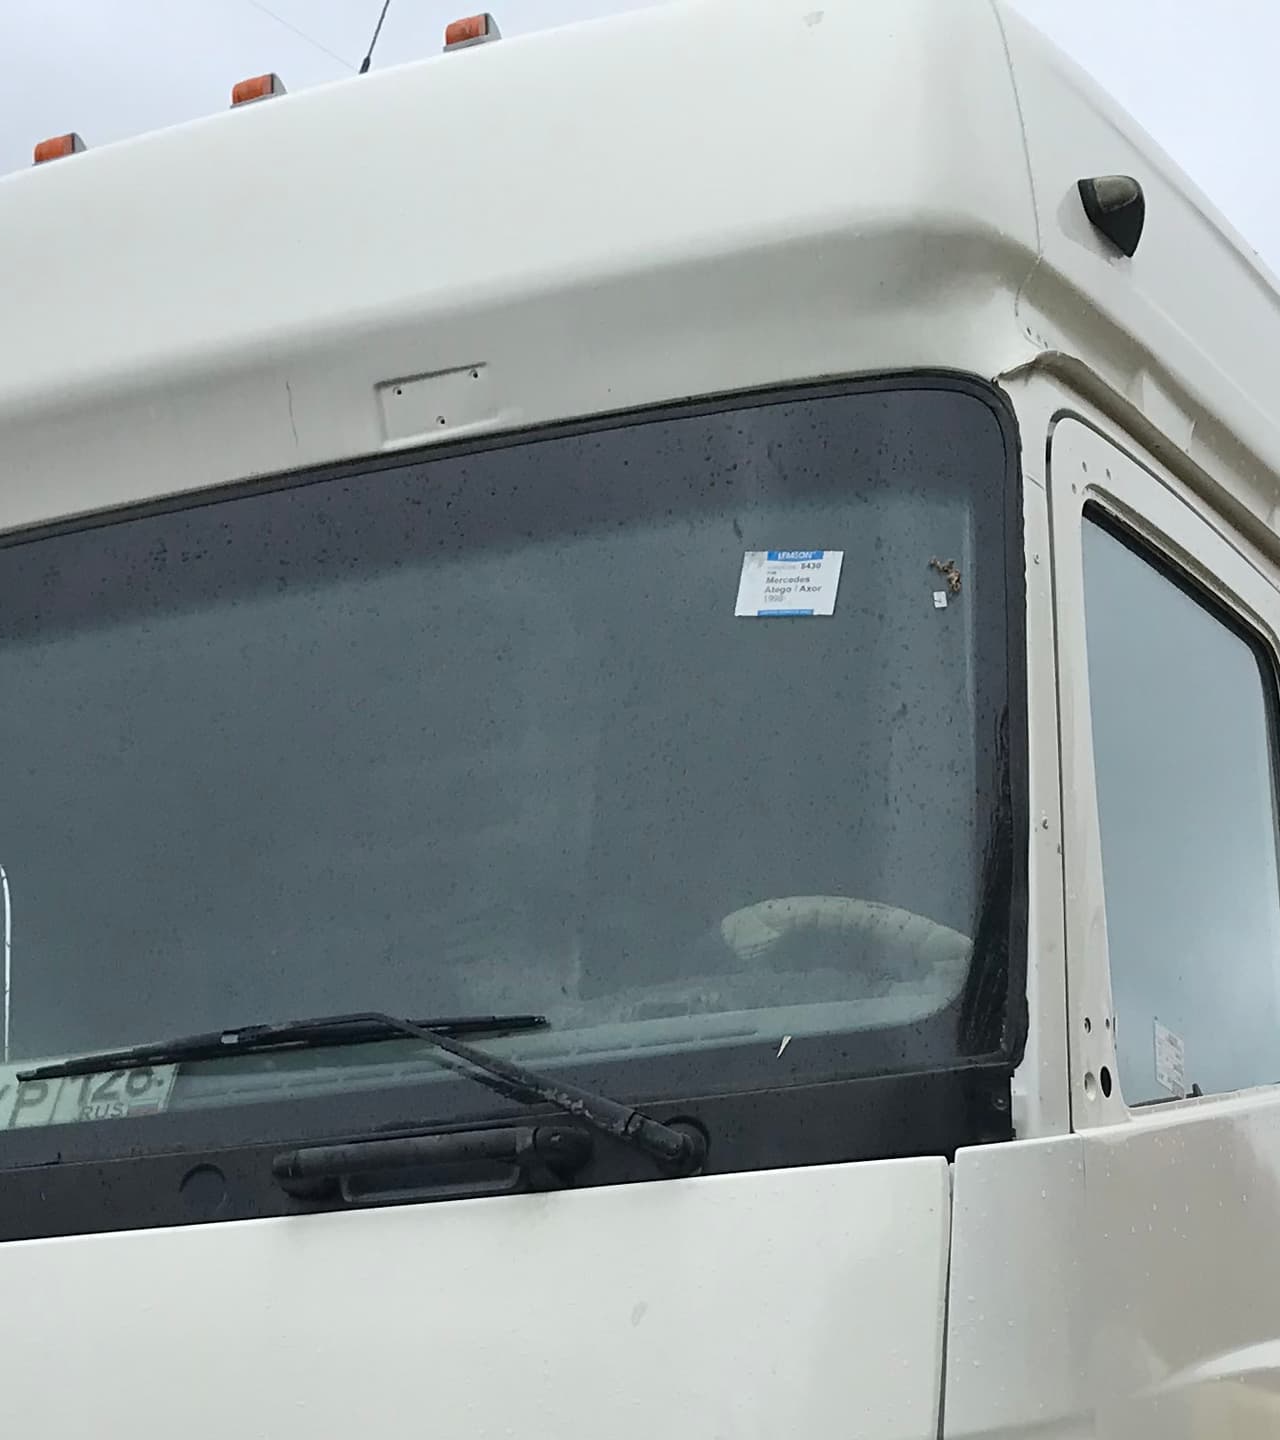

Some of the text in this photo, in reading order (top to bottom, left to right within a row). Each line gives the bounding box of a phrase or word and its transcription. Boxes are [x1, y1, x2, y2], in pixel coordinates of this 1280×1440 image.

[765, 576, 811, 584] Mercedes
[764, 586, 792, 594] Atego
[81, 1102, 125, 1121] RUS
